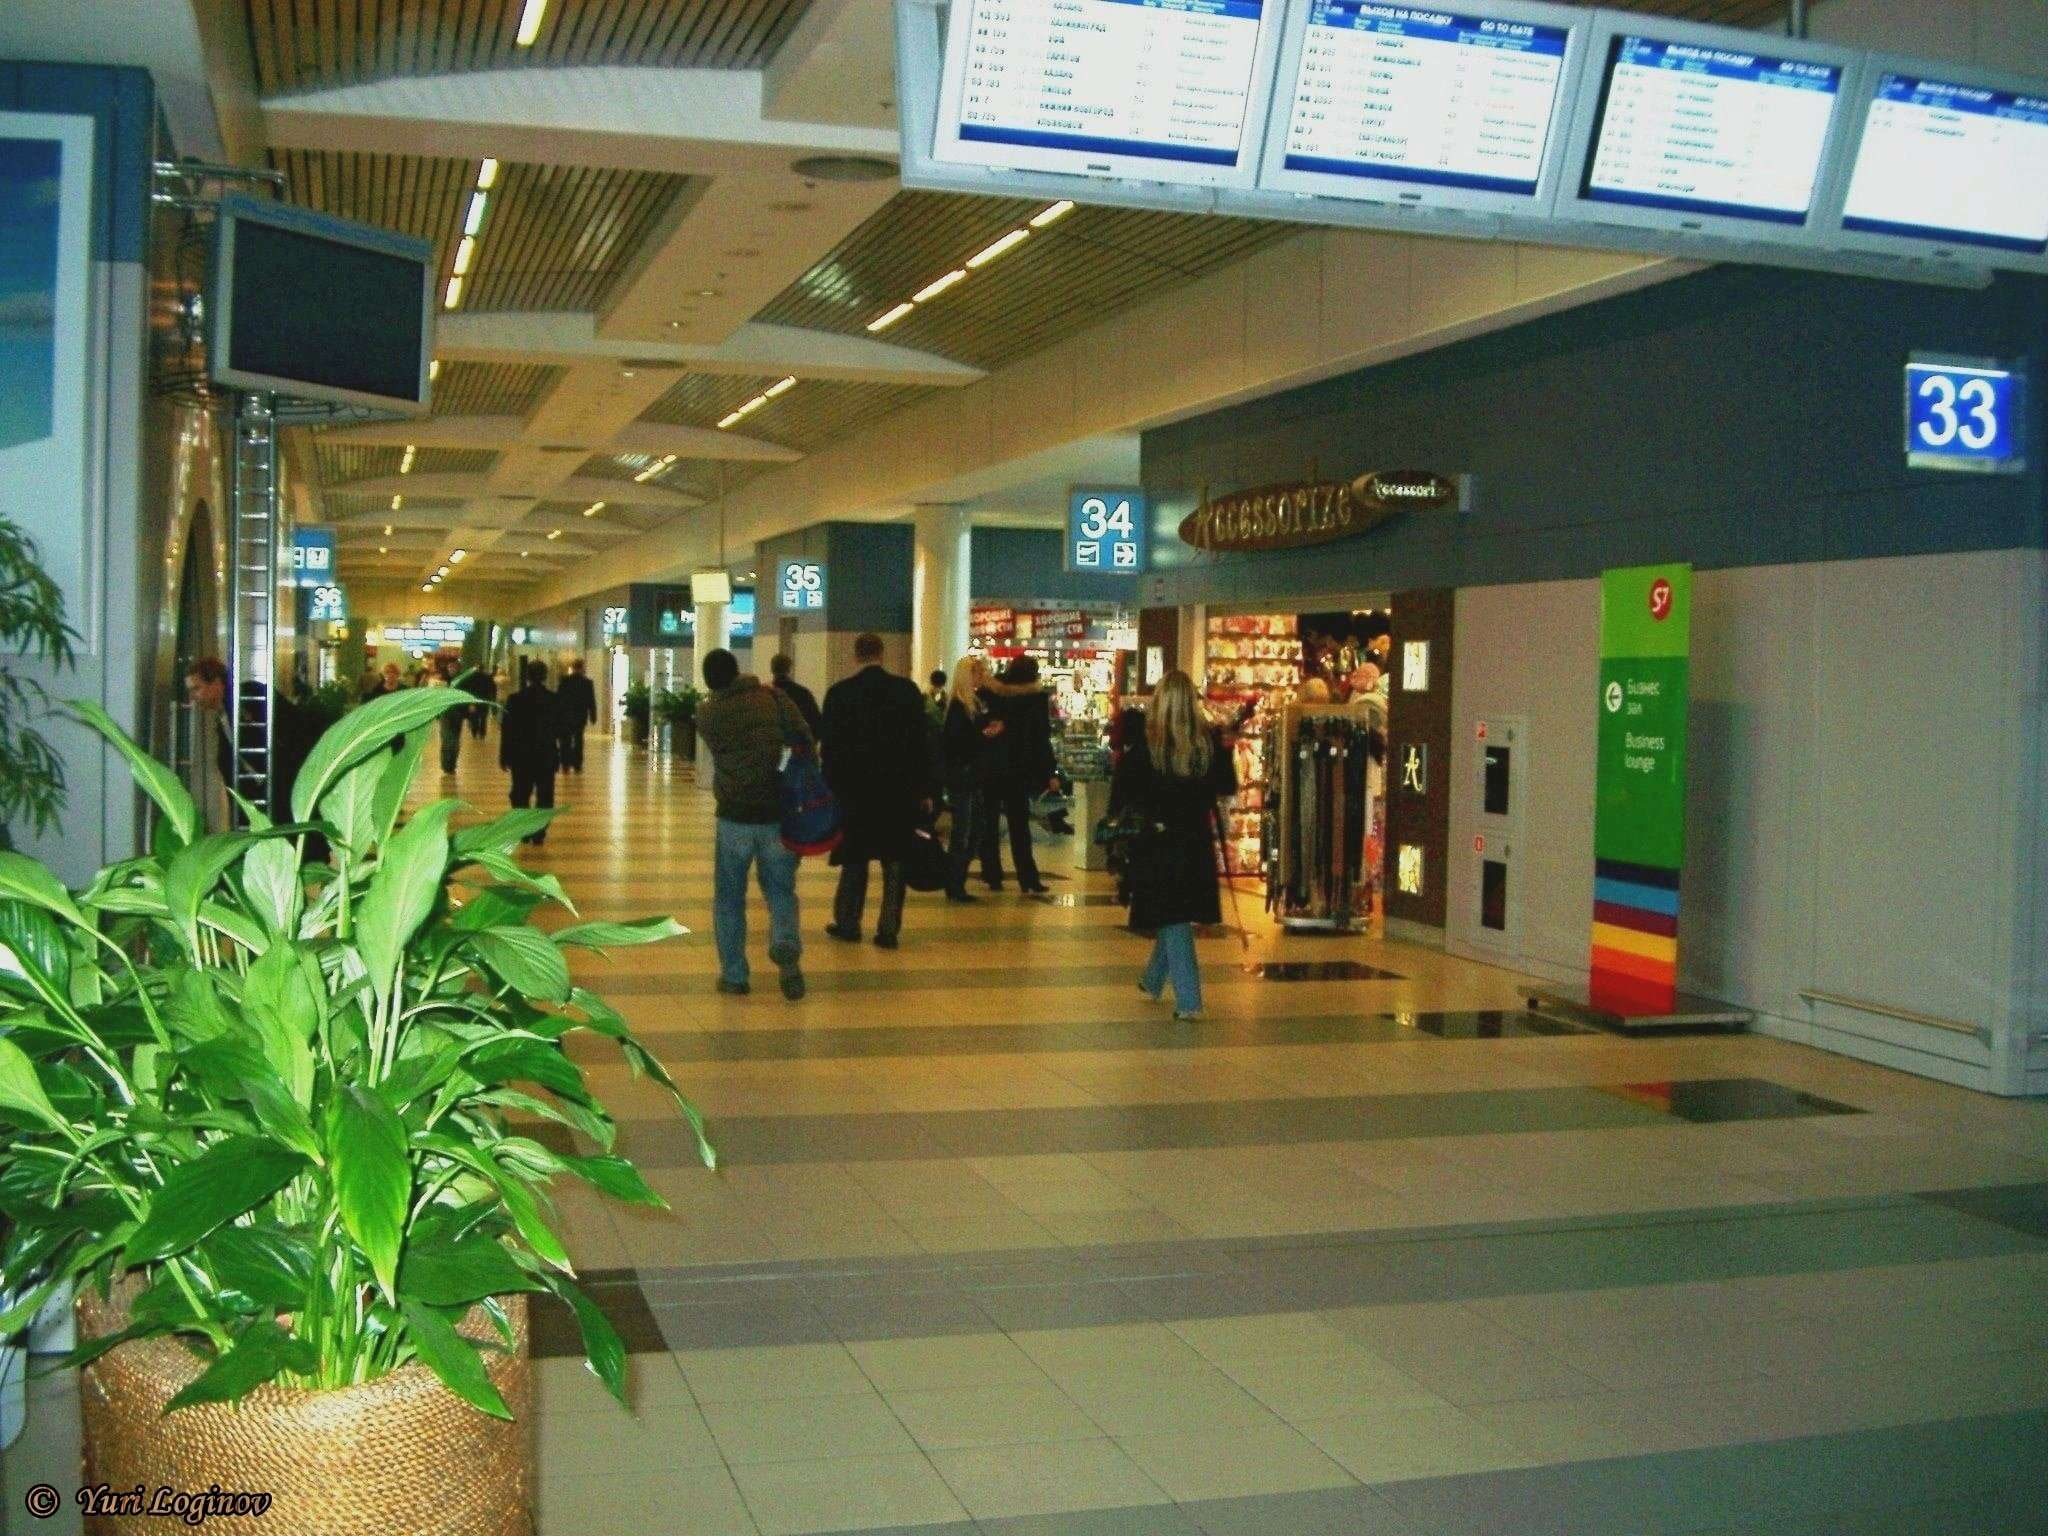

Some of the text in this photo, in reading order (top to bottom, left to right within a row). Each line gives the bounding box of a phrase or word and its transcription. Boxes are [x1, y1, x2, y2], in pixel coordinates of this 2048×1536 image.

[1918, 375, 1997, 449] 33
[1080, 498, 1134, 539] 34
[785, 564, 821, 591] 35
[314, 587, 341, 606] 36
[1652, 586, 1669, 613] S7
[604, 607, 627, 624] 37
[1625, 732, 1665, 750] Business
[1625, 754, 1656, 773] lounge
